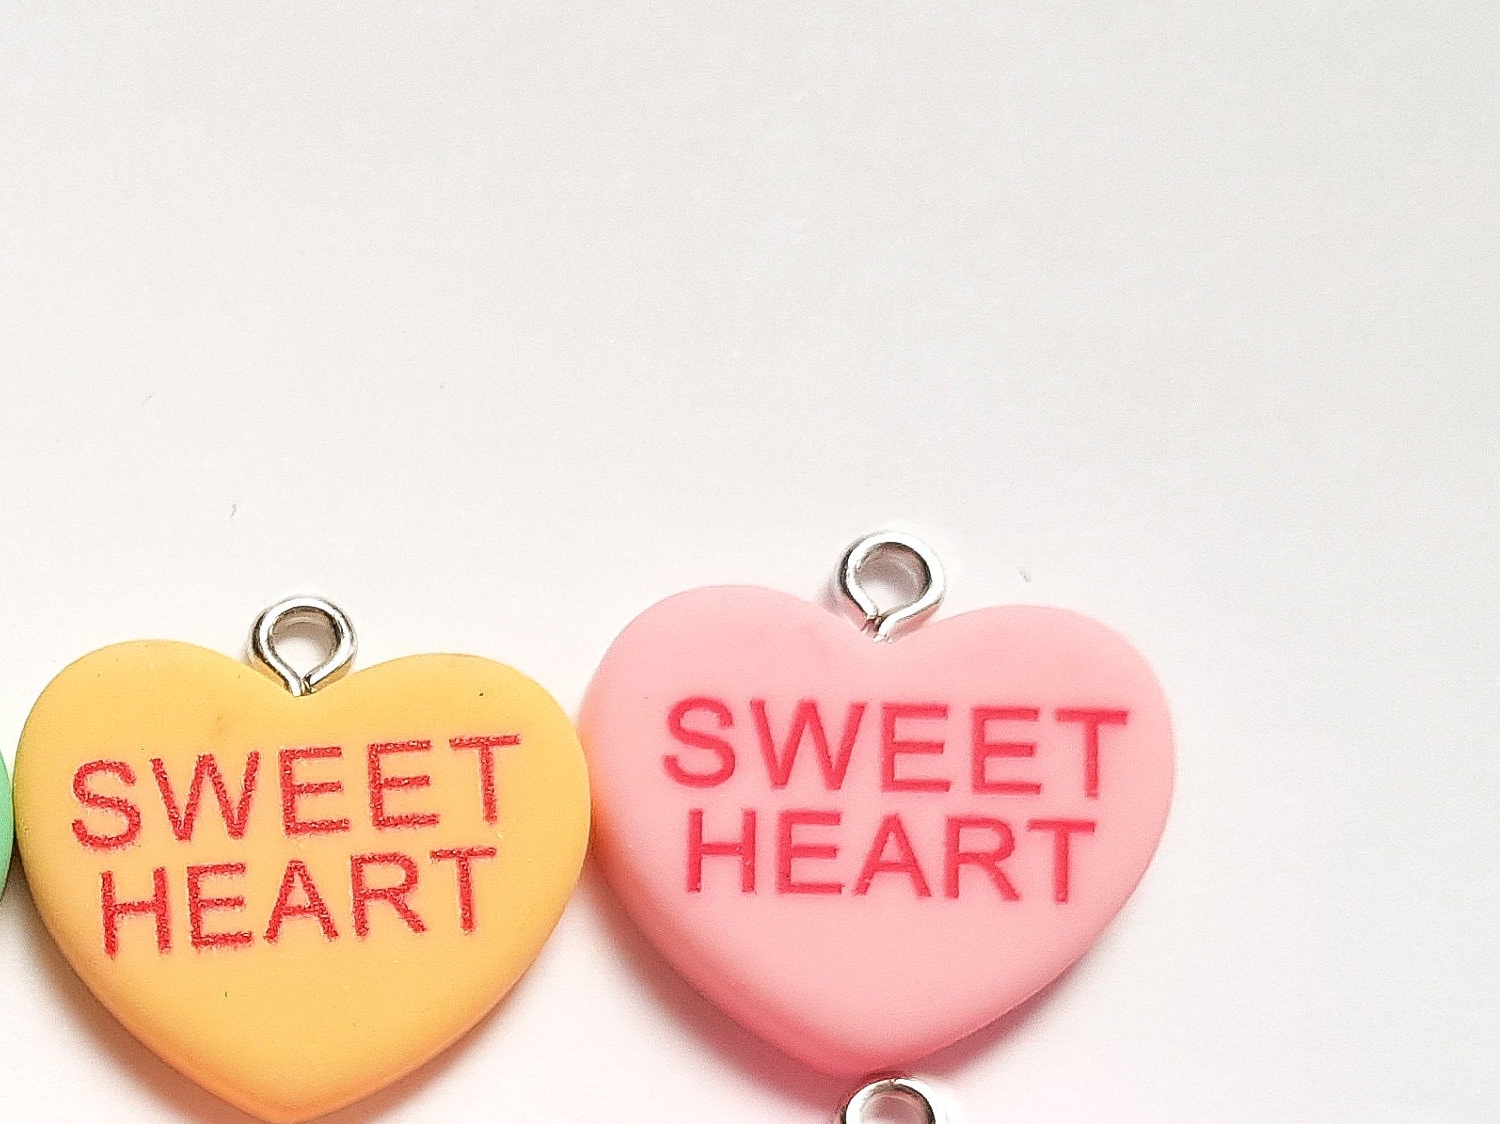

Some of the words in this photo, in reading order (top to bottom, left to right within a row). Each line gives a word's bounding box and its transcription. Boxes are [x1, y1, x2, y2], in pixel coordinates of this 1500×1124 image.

[70, 733, 522, 853] SWEET
[662, 695, 1131, 800] SWEET
[99, 845, 498, 962] HEART
[685, 807, 1098, 905] HEART
